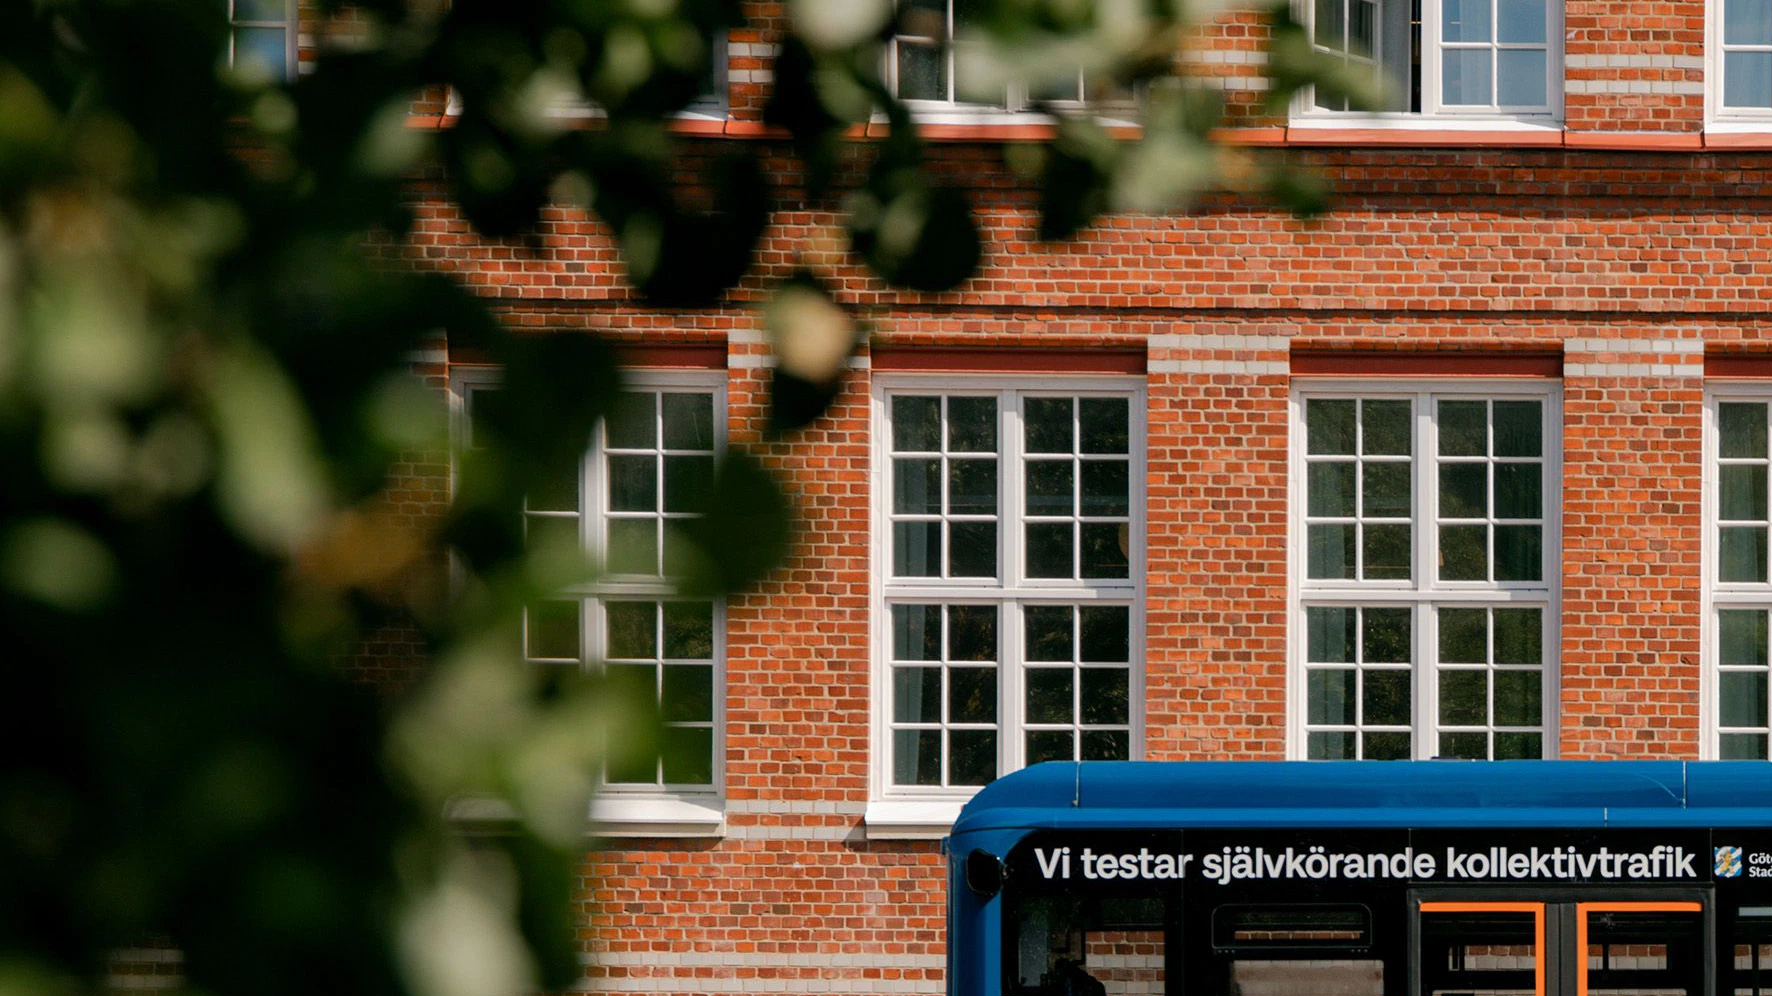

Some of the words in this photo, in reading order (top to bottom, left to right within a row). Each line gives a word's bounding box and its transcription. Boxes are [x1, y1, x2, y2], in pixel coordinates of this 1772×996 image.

[1034, 846, 1071, 879] Vi
[1080, 847, 1194, 880] testar
[1202, 845, 1436, 885] självkörande
[1447, 845, 1697, 879] kollektivtrafik
